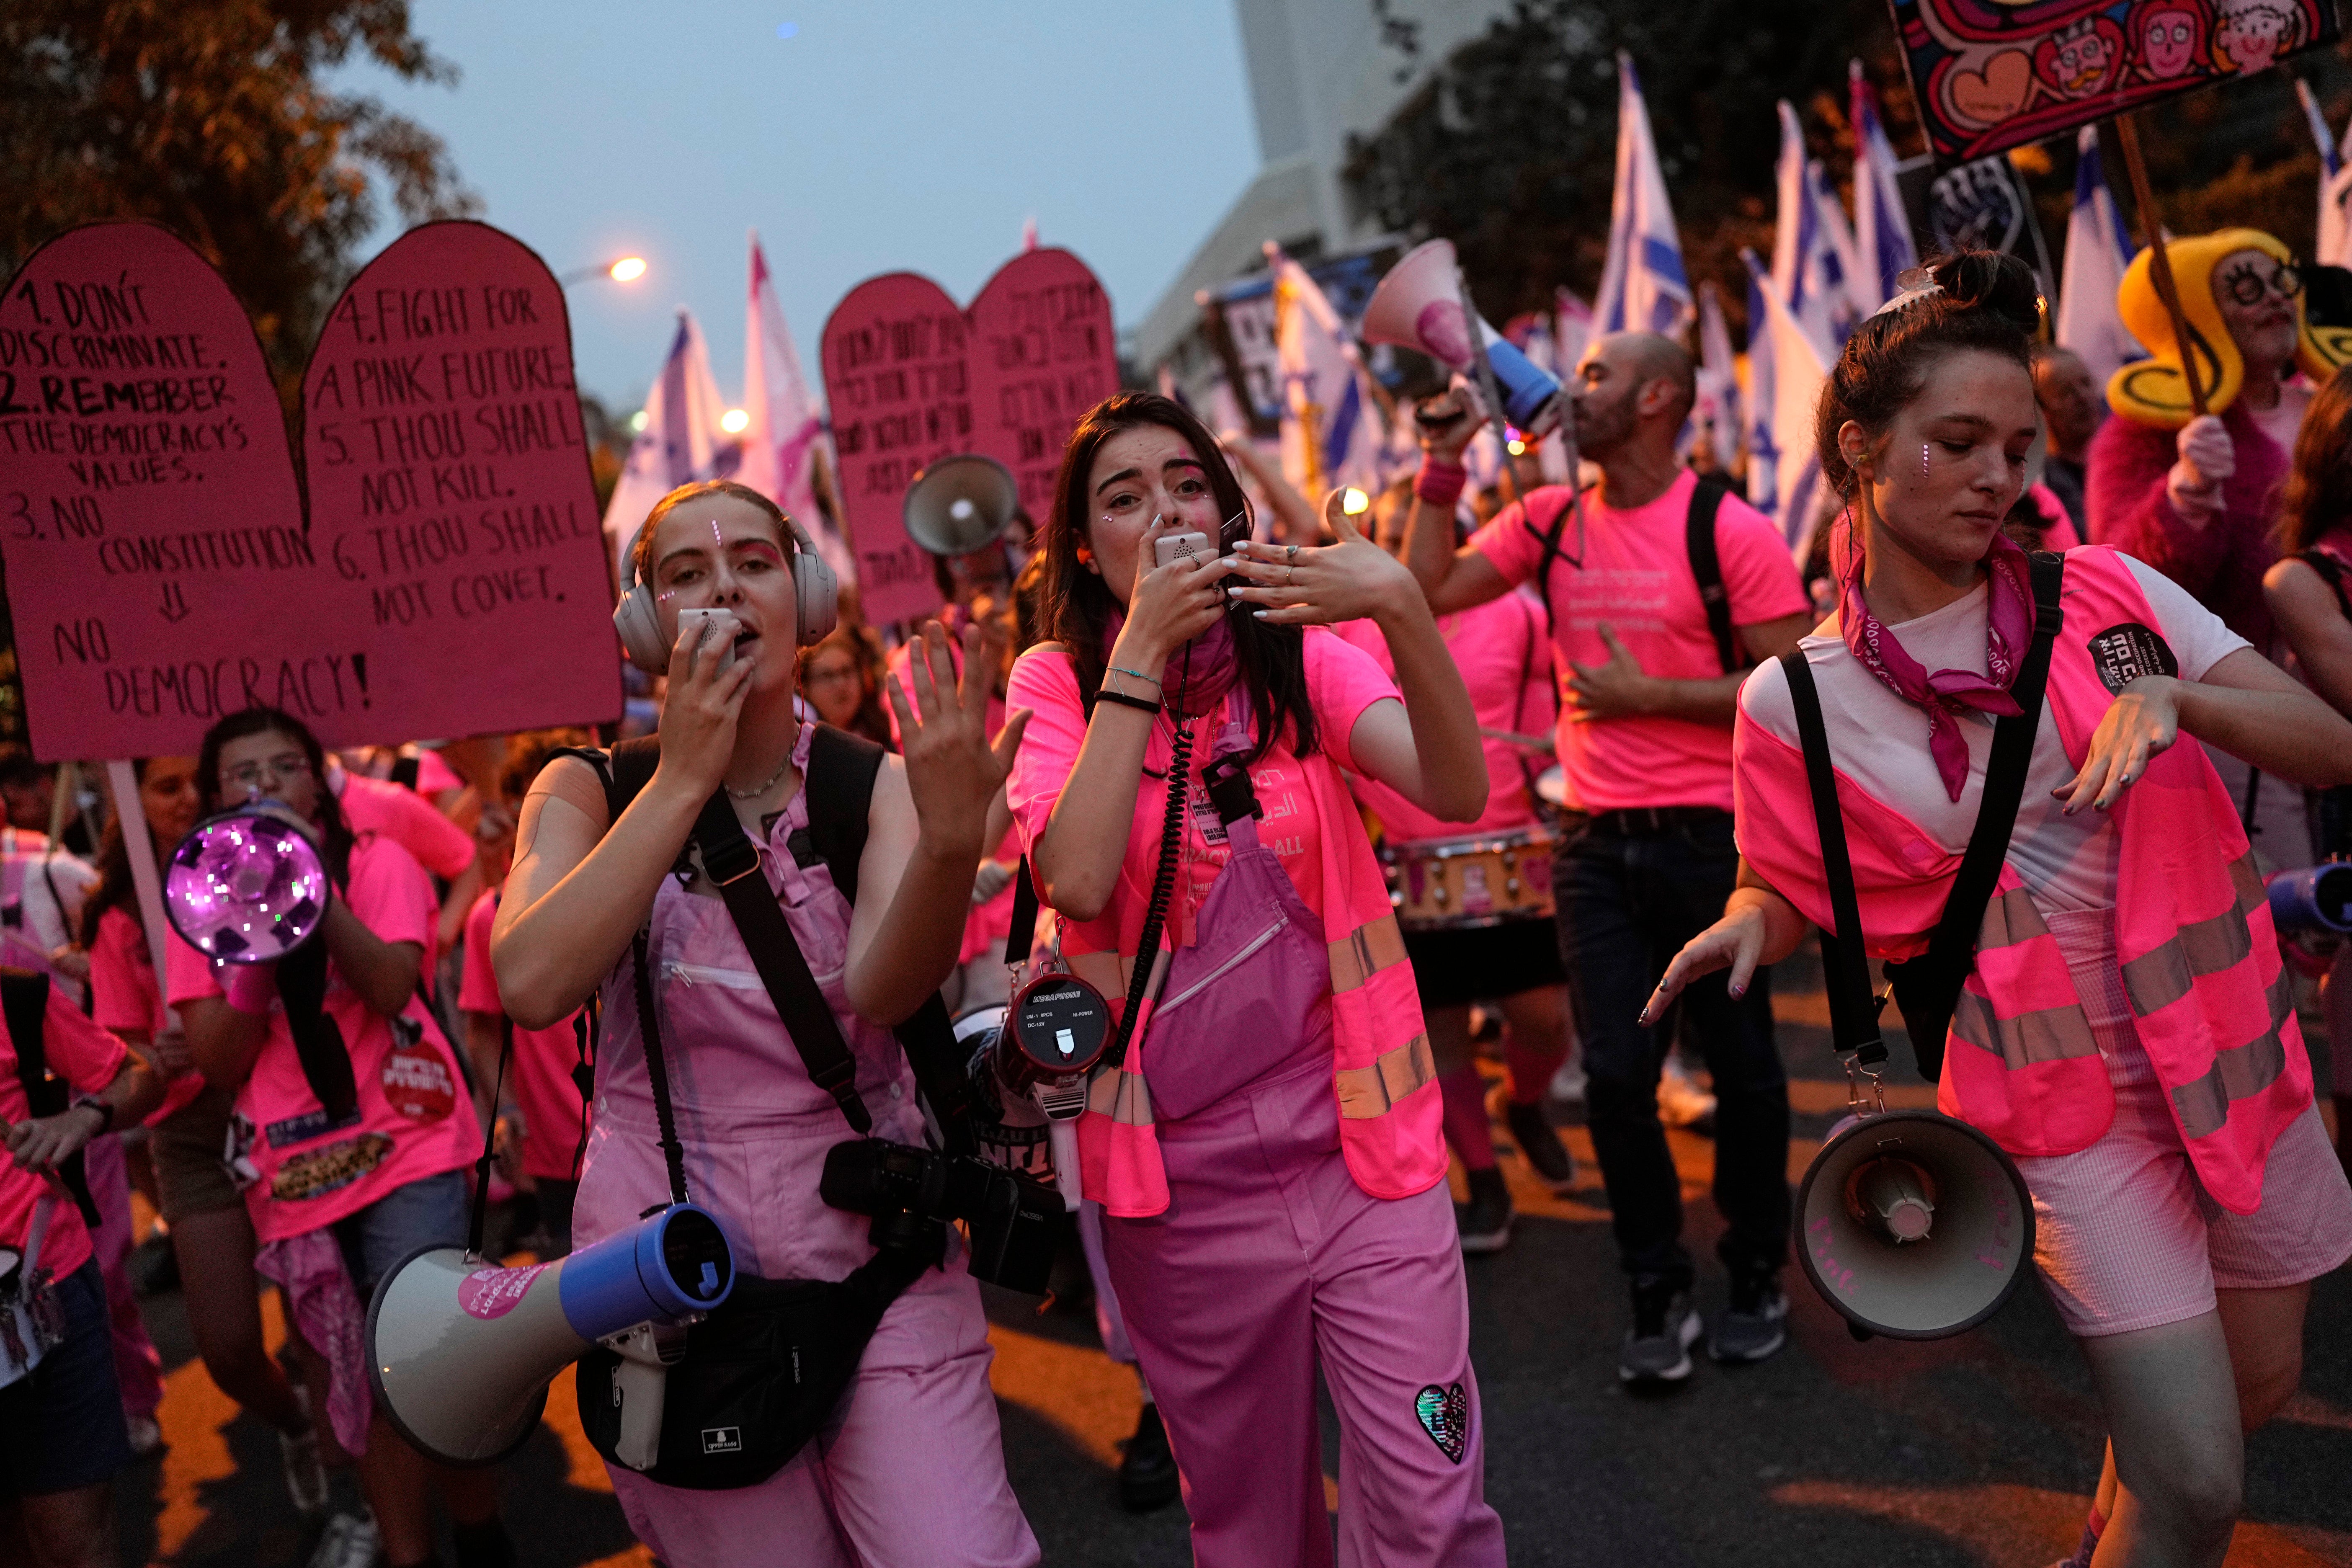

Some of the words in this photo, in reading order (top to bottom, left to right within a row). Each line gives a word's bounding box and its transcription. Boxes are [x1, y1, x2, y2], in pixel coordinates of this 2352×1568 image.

[483, 284, 539, 330] FOR
[0, 331, 227, 370] DISCRIMINATE.
[313, 363, 345, 410] A
[352, 353, 434, 407] PINK
[441, 346, 575, 402] FUTURE.
[1, 420, 66, 455] THE
[69, 415, 249, 456] DEMOCRACY'S
[319, 423, 354, 467] 5.
[361, 406, 467, 464] THOU
[475, 398, 581, 458] SHALL
[68, 455, 204, 490] VALUES.
[361, 468, 420, 518] NOT
[431, 463, 516, 504] KILL.
[9, 490, 46, 540] 3.
[50, 494, 104, 541] NO
[98, 524, 317, 575] CONSTITUTION
[333, 532, 367, 581] 6.
[366, 514, 468, 575] THOU
[479, 500, 593, 556] SHALL
[372, 580, 434, 626] NOT
[451, 564, 567, 620] COVET.
[53, 616, 111, 665] NO
[2099, 638, 2115, 655] אין
[2112, 634, 2131, 660] עם
[2128, 632, 2142, 664] OCCUPATION
[2140, 647, 2150, 667] COEXIST
[104, 652, 371, 717] DEMOCRACY!
[1274, 836, 1305, 857] ALL
[1033, 990, 1081, 1003] MEGAPHONE
